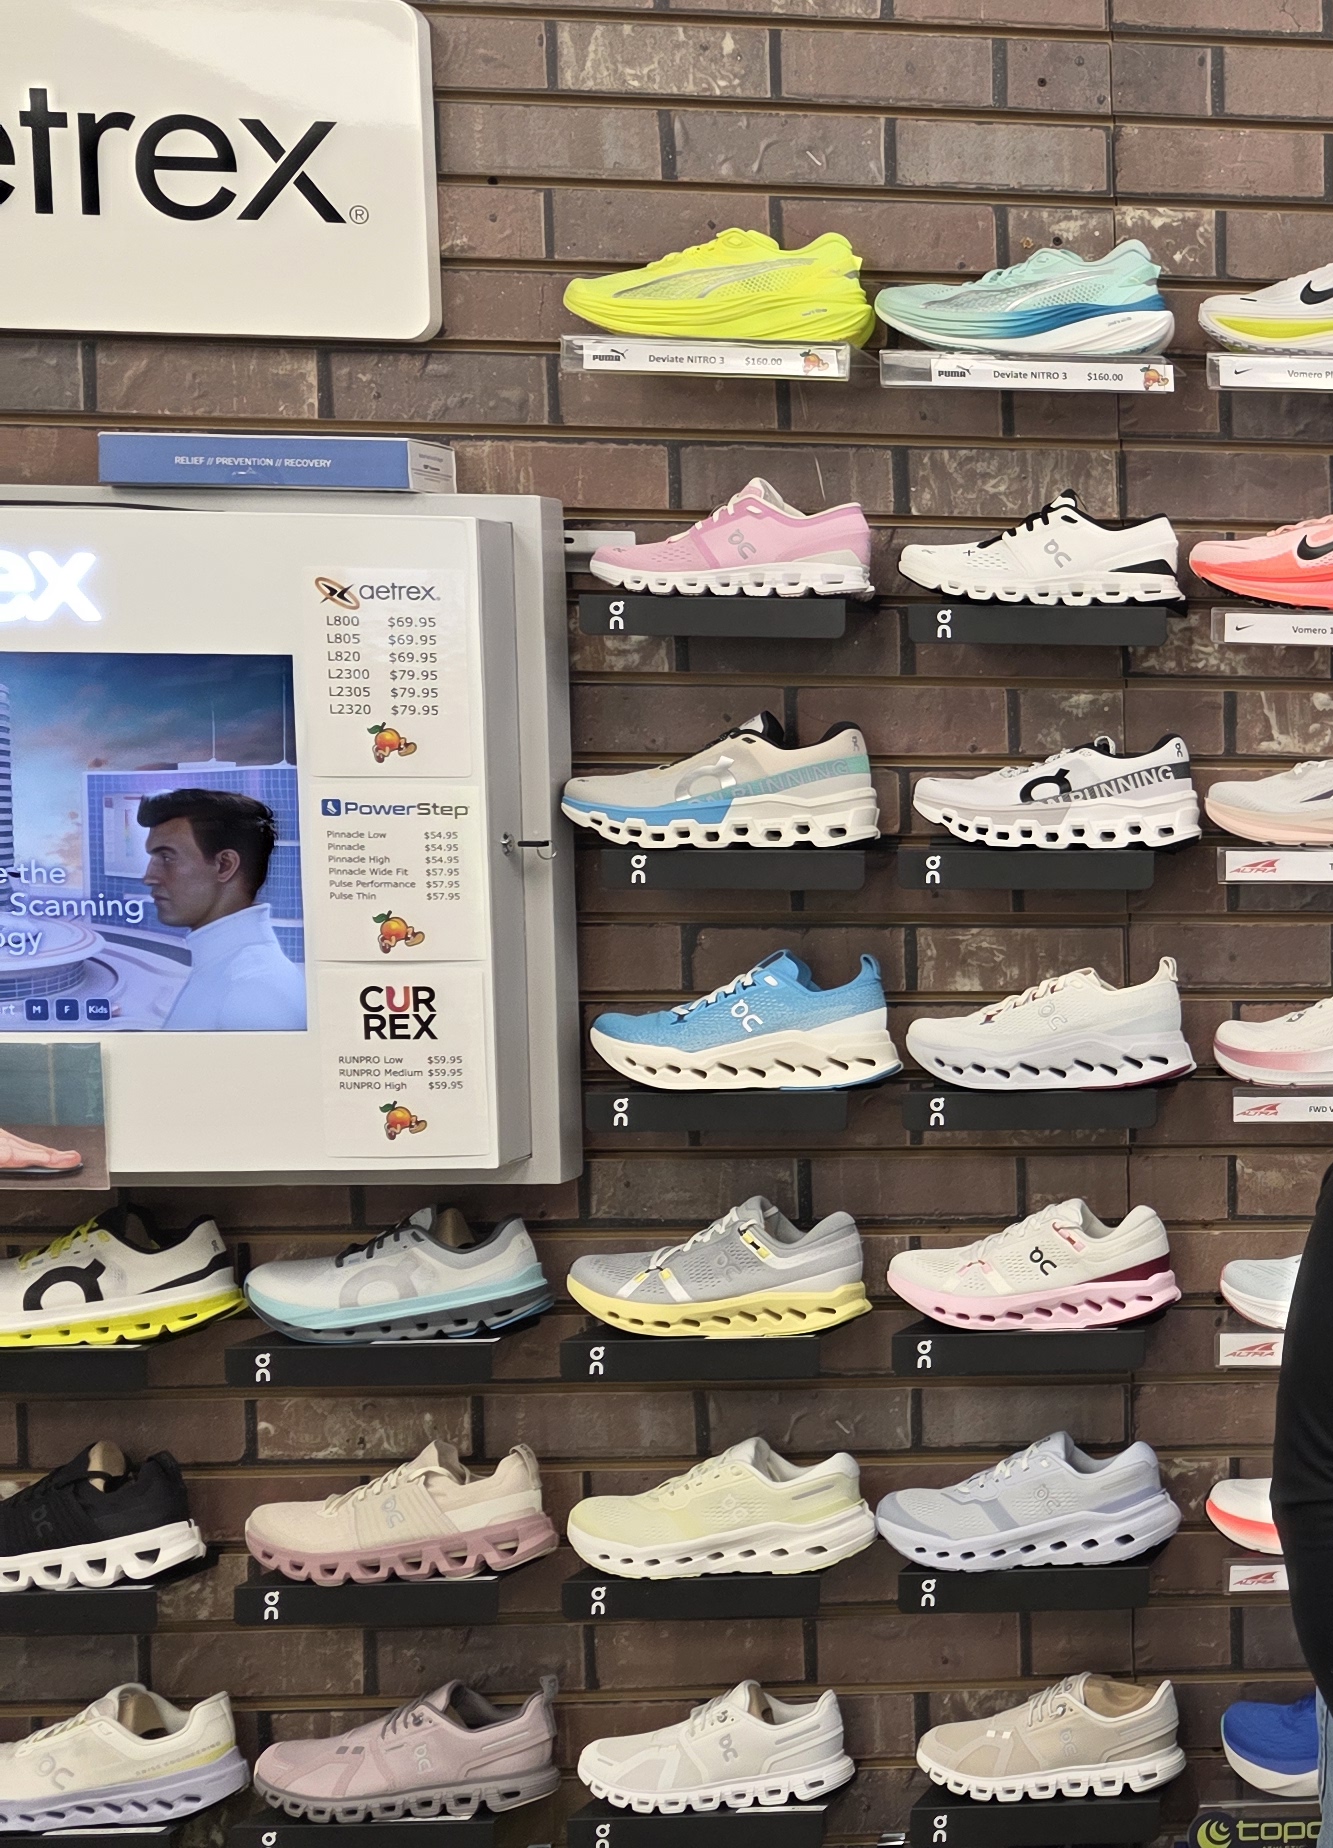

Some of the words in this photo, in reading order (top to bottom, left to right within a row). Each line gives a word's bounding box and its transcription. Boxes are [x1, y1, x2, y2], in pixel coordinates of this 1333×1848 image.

[0, 88, 346, 224] trex
[592, 353, 621, 362] PUMA
[648, 354, 685, 365] Deviate
[686, 355, 716, 365] NITRO
[718, 356, 725, 365] 3
[745, 357, 783, 366] $160.00
[937, 370, 966, 378] PUMA
[993, 370, 1028, 381] Deviate
[1030, 371, 1060, 380] NITRO
[1062, 372, 1068, 380] 3
[1087, 371, 1124, 382] $160.00
[1287, 370, 1322, 379] Vomero
[175, 456, 205, 465] RELIEF
[215, 458, 273, 467] PREVENTION
[284, 459, 332, 468] RECOVERY
[359, 582, 436, 601] aetrex
[326, 615, 360, 626] L800
[387, 616, 436, 629] $69.95
[1292, 626, 1327, 635] Vomero
[326, 633, 361, 644] L805
[388, 634, 437, 647] $69.95
[327, 651, 361, 661] L820
[389, 652, 438, 664] $69.95
[328, 668, 370, 679] L2300
[389, 669, 438, 682] $79.95
[329, 686, 370, 697] L2305
[390, 687, 439, 700] $79.95
[329, 704, 371, 715] L2320
[391, 705, 439, 717] $79.95
[345, 801, 469, 819] PowerStep
[326, 830, 365, 839] Pinnacle
[367, 831, 387, 839] Low
[424, 831, 458, 841] $54.95
[327, 843, 365, 851] Pinnacle
[424, 843, 459, 852] $54.95
[328, 855, 366, 864] Pinnacle
[369, 855, 390, 865] High
[425, 855, 459, 865] $54.95
[20, 860, 66, 884] the
[328, 867, 366, 876] Pinnacle
[369, 867, 393, 876] Wide
[395, 868, 408, 876] Fit
[425, 868, 460, 877] $57.95
[329, 880, 353, 888] Pulse
[356, 880, 416, 889] Performance
[426, 880, 460, 889] $57.95
[330, 892, 353, 900] Pulse
[356, 892, 376, 900] Thin
[426, 892, 461, 901] $57.95
[10, 892, 144, 923] Scanning
[359, 985, 437, 1013] CUR
[33, 1005, 41, 1014] M
[64, 1005, 70, 1014] F
[88, 1005, 108, 1014] Kids
[363, 1014, 438, 1040] REX
[338, 1056, 380, 1064] RUNPRO
[383, 1056, 404, 1064] Low
[427, 1056, 463, 1065] $59.95
[339, 1069, 381, 1077] RUNPRO
[384, 1069, 423, 1077] Medium
[428, 1069, 463, 1078] $59.95
[339, 1082, 381, 1090] RUNPRO
[385, 1082, 407, 1091] High
[428, 1081, 463, 1090] $59.95
